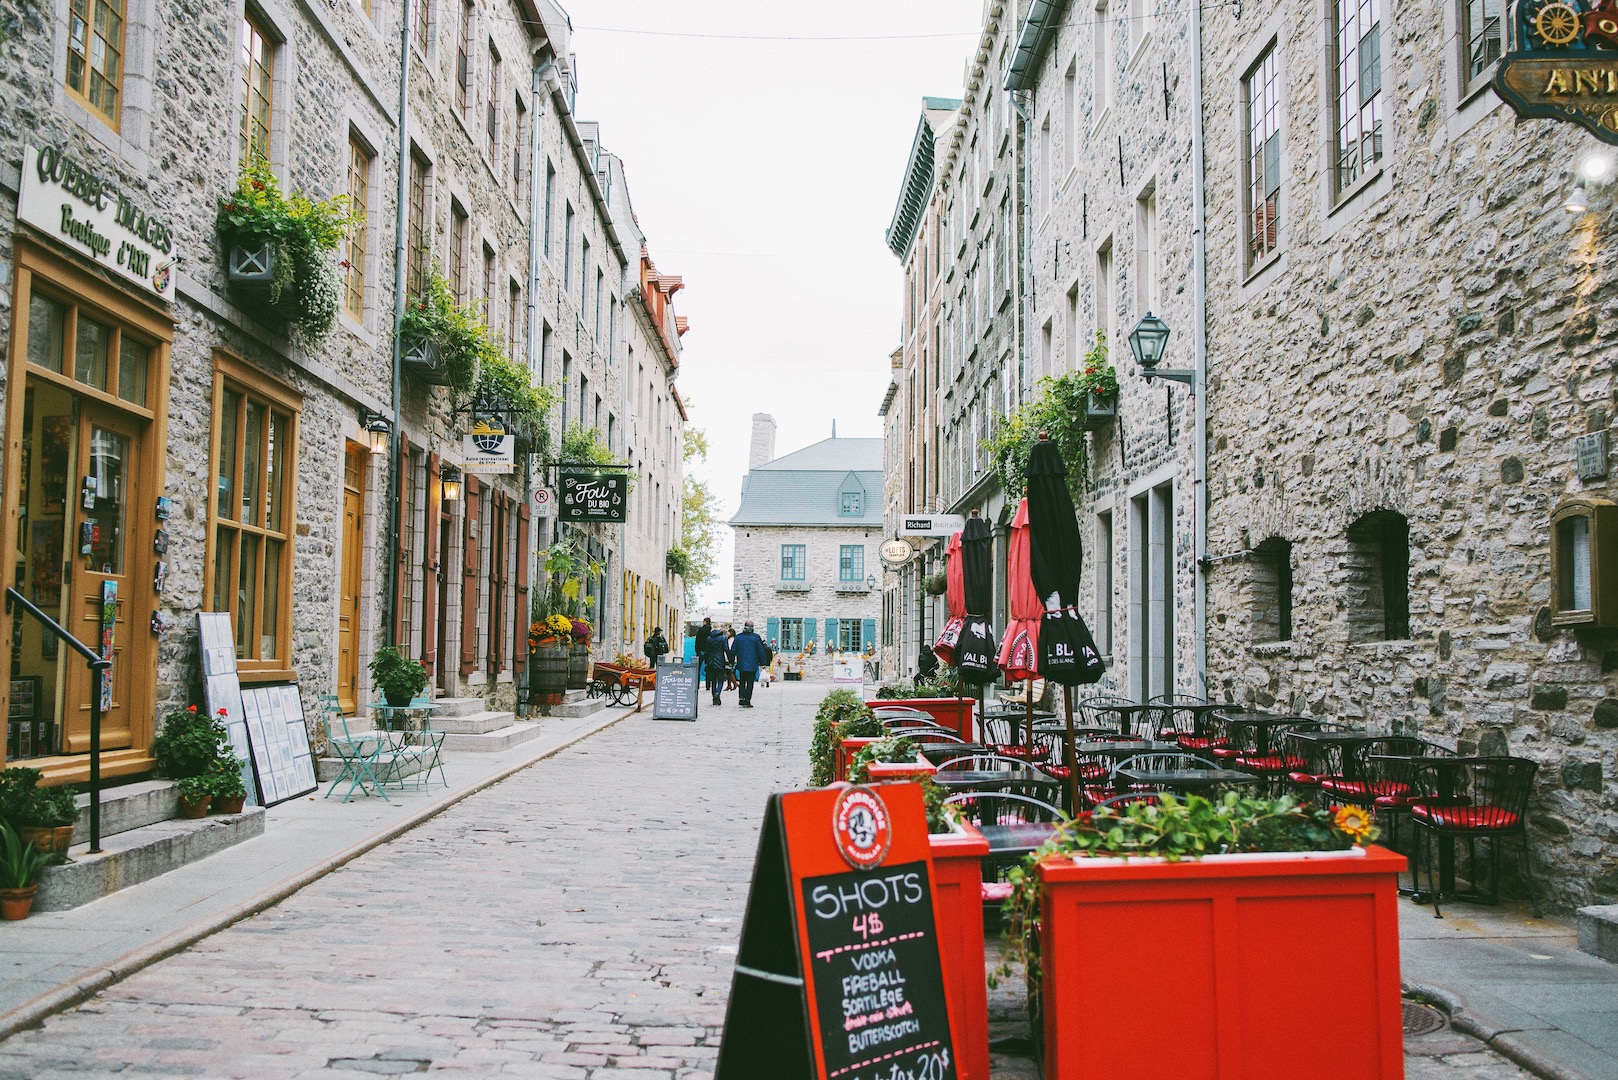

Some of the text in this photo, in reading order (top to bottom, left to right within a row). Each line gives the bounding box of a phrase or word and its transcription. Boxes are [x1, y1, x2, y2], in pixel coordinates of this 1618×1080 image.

[114, 193, 173, 255] IMAGES
[60, 203, 151, 279] Boutique d'ART
[575, 480, 609, 503] Fou
[587, 499, 609, 508] DU BIO
[812, 873, 922, 919] SHOTS
[852, 912, 884, 940] 4$
[851, 948, 896, 971] VODKA
[848, 1019, 920, 1054] BUTTERSCOTCH
